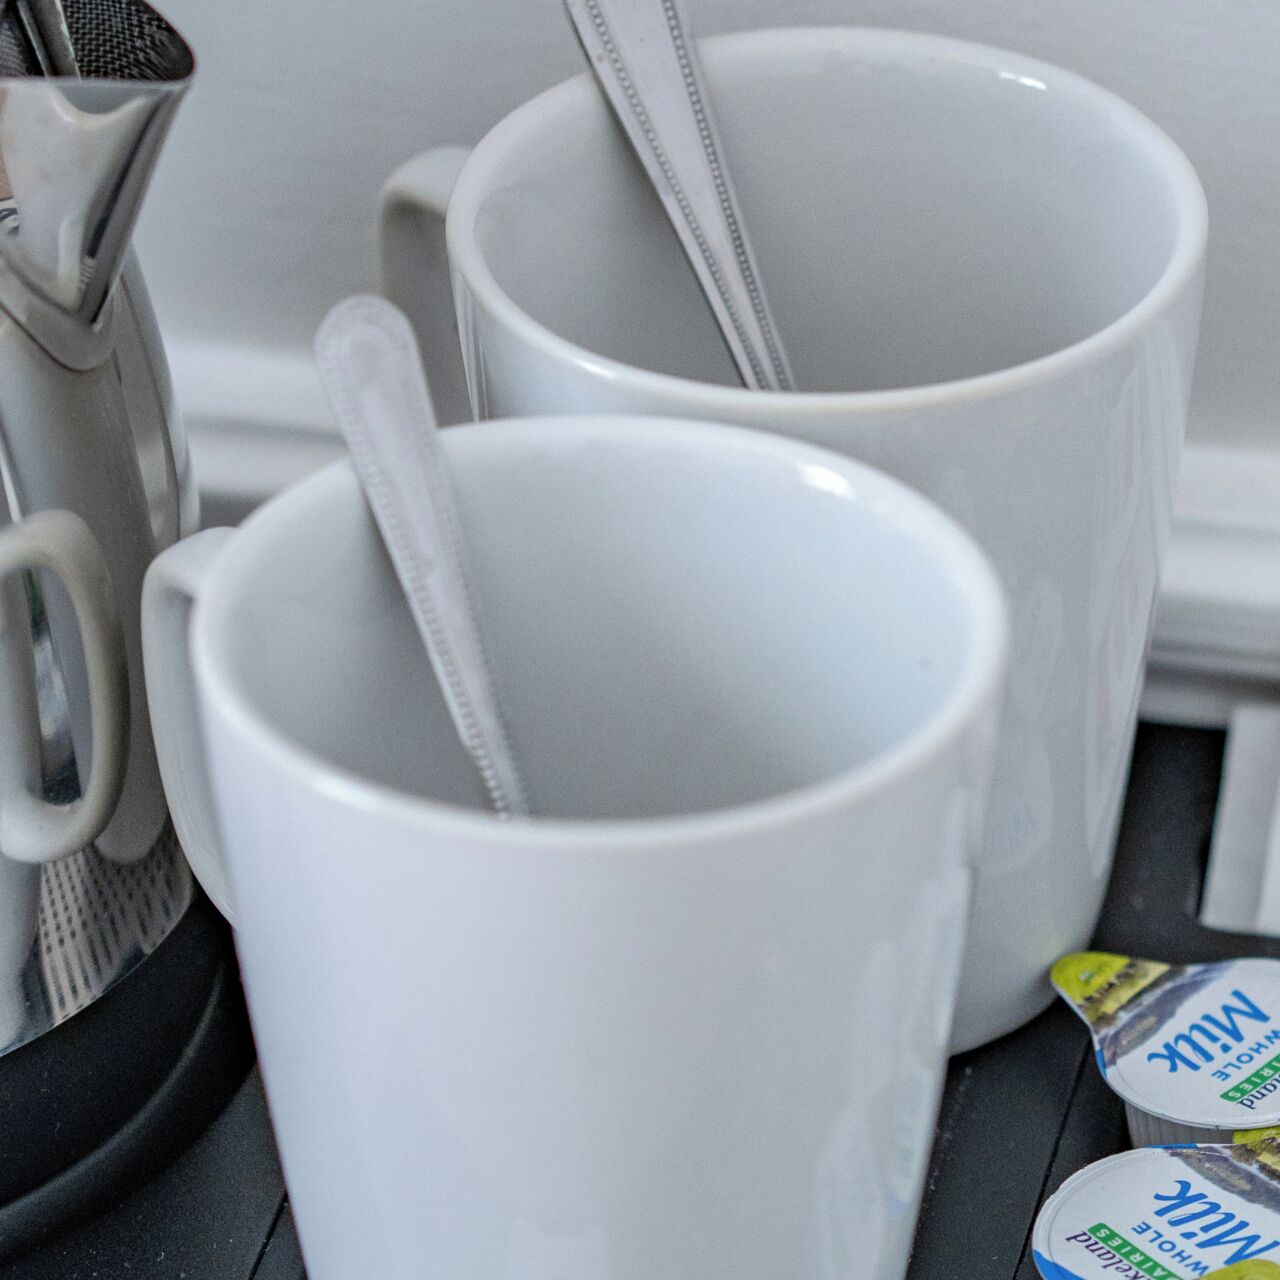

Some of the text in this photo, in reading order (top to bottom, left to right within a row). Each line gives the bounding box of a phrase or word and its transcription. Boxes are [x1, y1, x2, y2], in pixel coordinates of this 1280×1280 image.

[1147, 989, 1270, 1073] Milk
[1132, 1221, 1210, 1277] WHOLE
[1153, 1180, 1280, 1265] Milk
